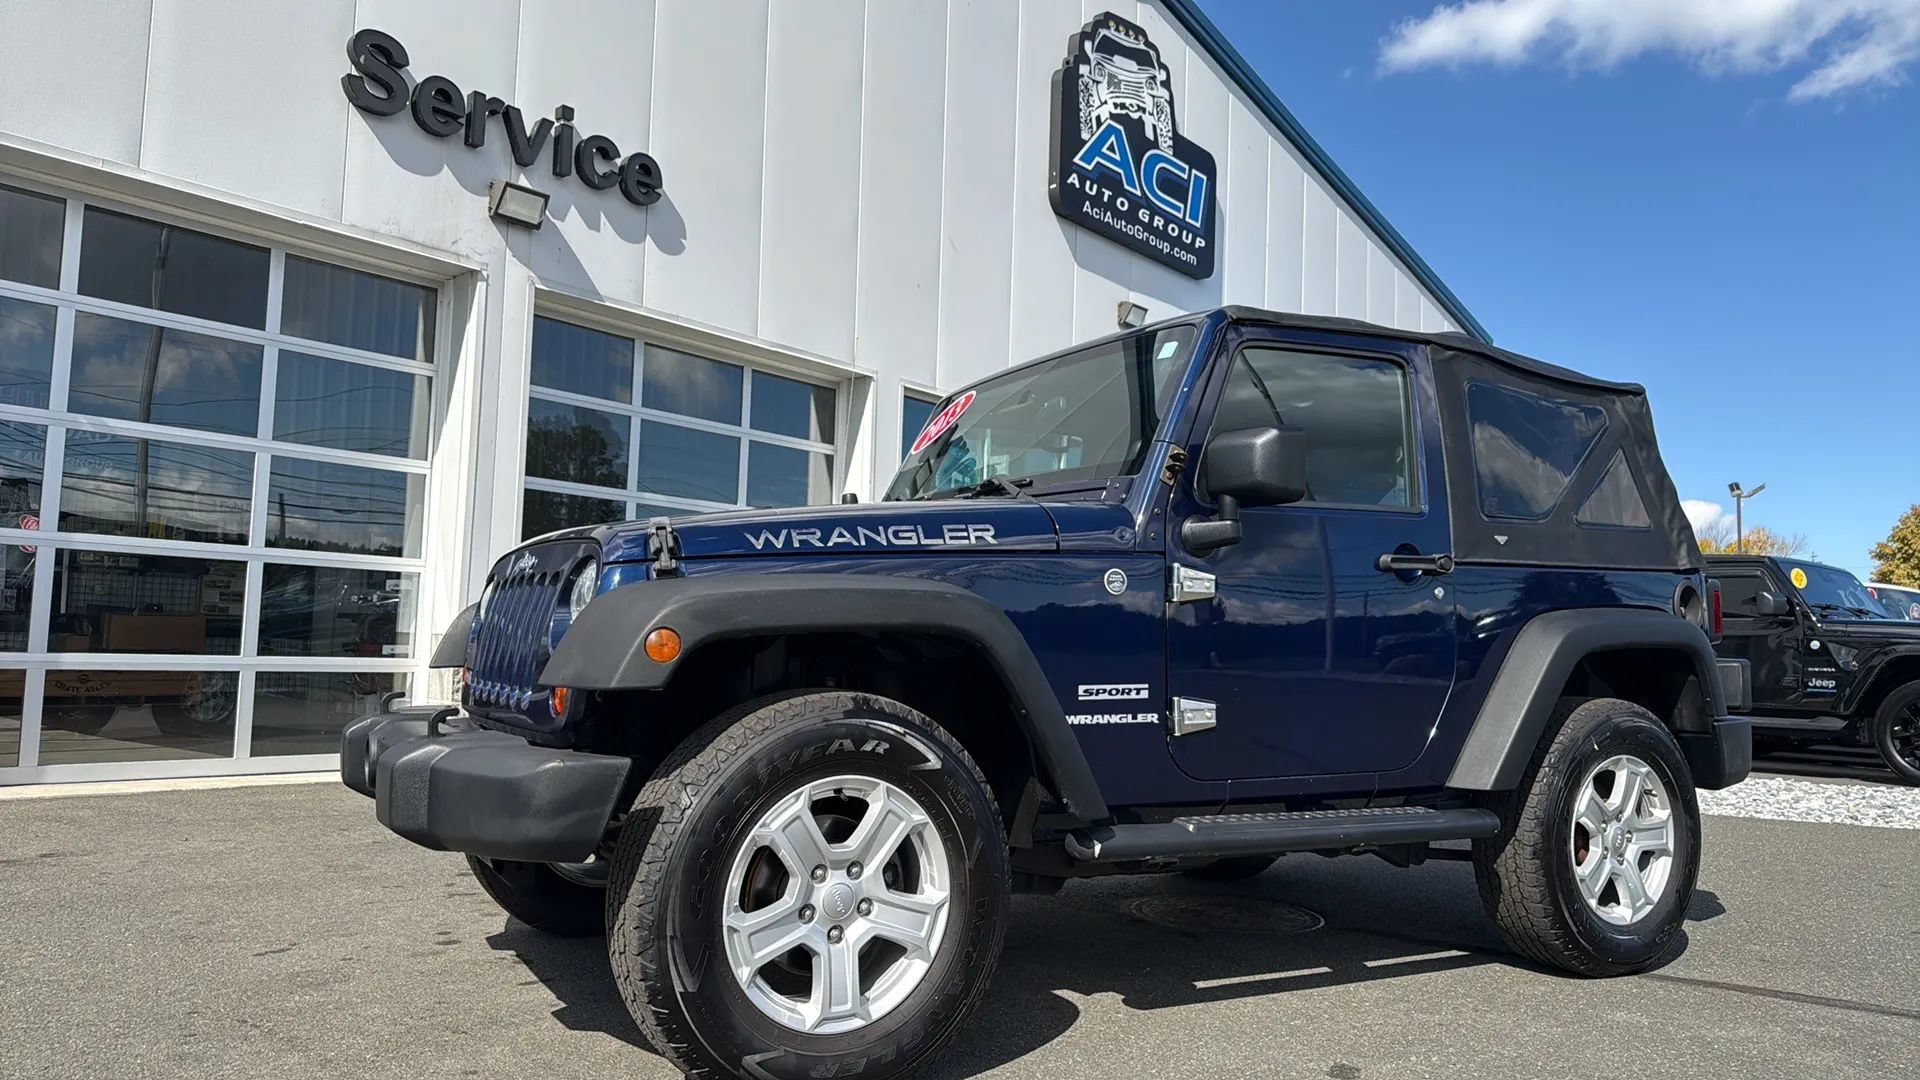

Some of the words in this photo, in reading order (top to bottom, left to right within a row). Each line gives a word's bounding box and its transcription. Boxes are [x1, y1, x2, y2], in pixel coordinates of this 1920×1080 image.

[341, 28, 663, 206] Service
[1073, 119, 1208, 230] ACI
[1066, 172, 1129, 212] AUTO
[1138, 208, 1206, 249] GROUP
[1082, 200, 1197, 267] AciAutoGroup.com
[744, 523, 999, 551] WRANGLER
[1080, 687, 1145, 697] SPORT
[1808, 677, 1836, 689] Jeep
[1065, 713, 1159, 724] WRANGLER
